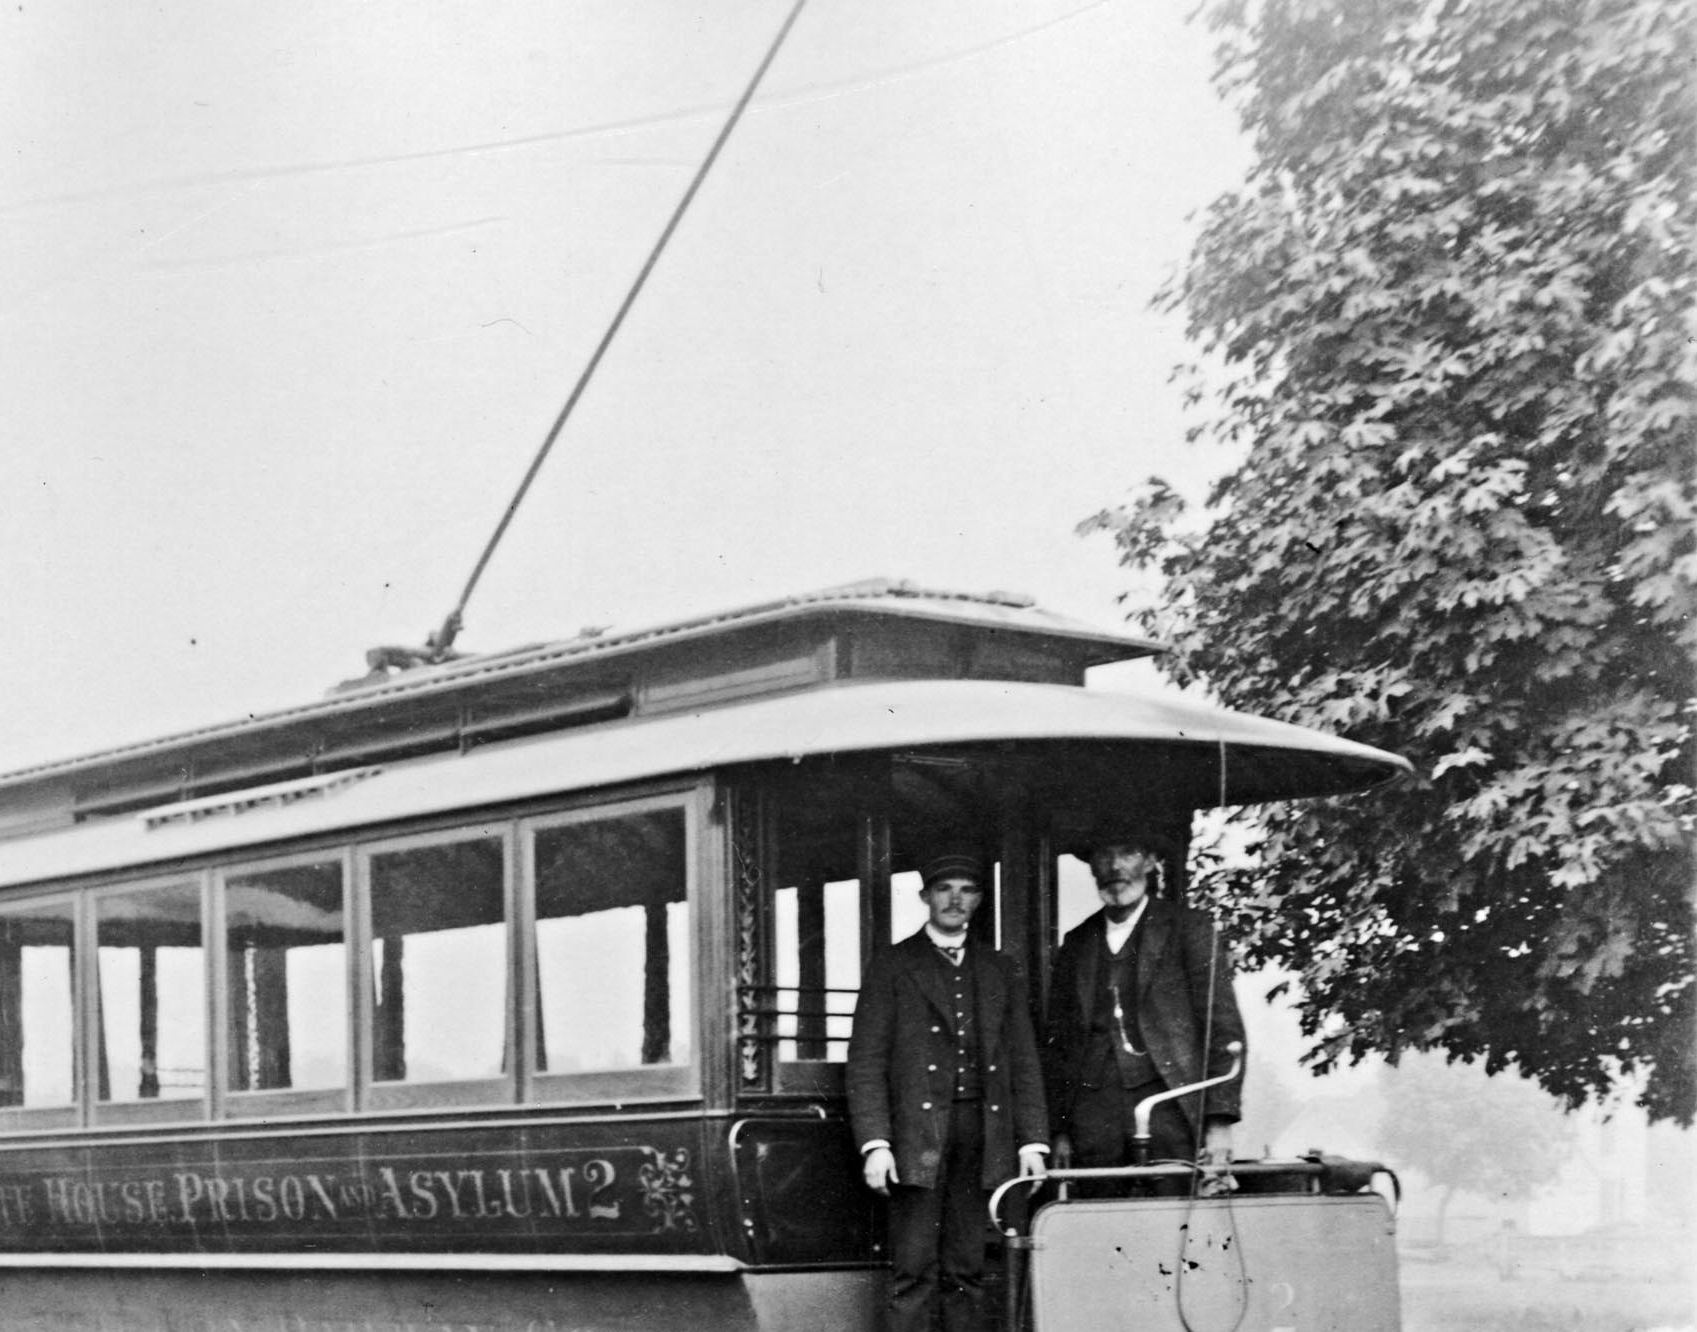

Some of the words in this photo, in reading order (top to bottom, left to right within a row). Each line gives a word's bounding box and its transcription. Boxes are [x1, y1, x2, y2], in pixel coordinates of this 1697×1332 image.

[174, 1172, 338, 1223] PRISON
[380, 1166, 581, 1220] ASYLUM
[583, 1159, 620, 1219] 2
